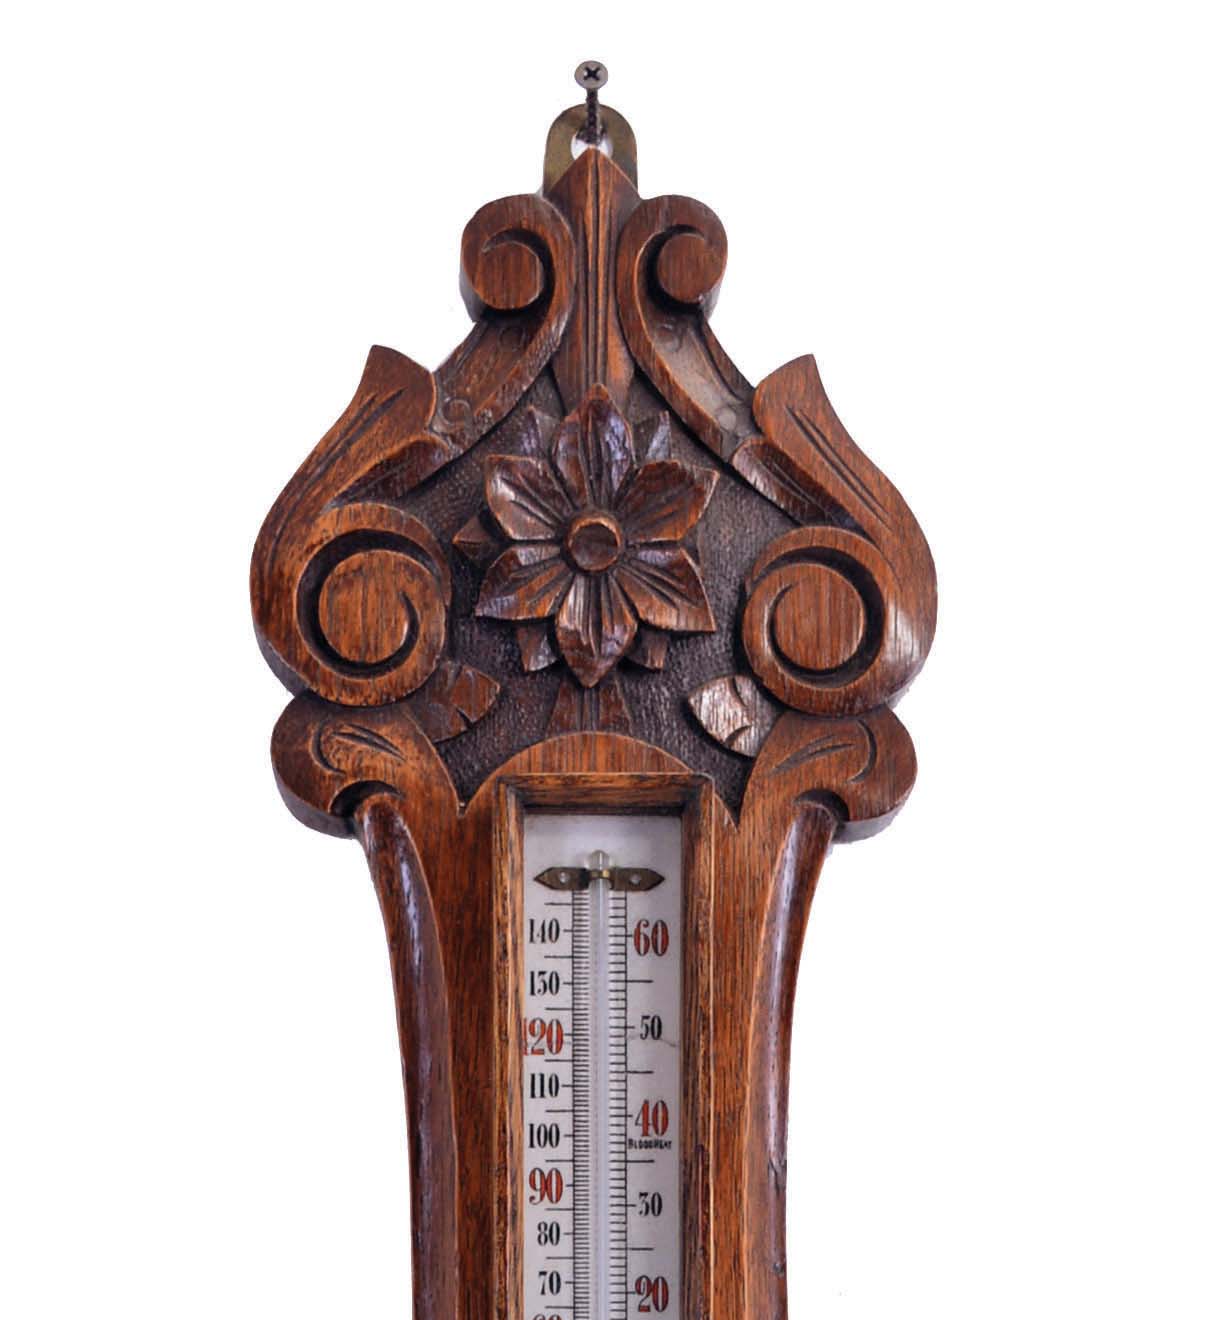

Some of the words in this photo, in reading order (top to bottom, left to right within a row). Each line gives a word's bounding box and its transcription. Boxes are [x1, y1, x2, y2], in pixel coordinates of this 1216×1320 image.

[529, 918, 561, 944] 140
[633, 919, 670, 958] 60
[529, 970, 560, 997] 130
[522, 1018, 563, 1056] 120
[639, 1014, 663, 1041] 50
[530, 1072, 560, 1099] 110
[634, 1099, 670, 1138] 40
[528, 1123, 561, 1149] 100
[528, 1167, 564, 1205] 90
[638, 1191, 663, 1217] 30
[537, 1221, 561, 1246] 80
[538, 1270, 562, 1296] 70
[635, 1275, 670, 1313] 20
